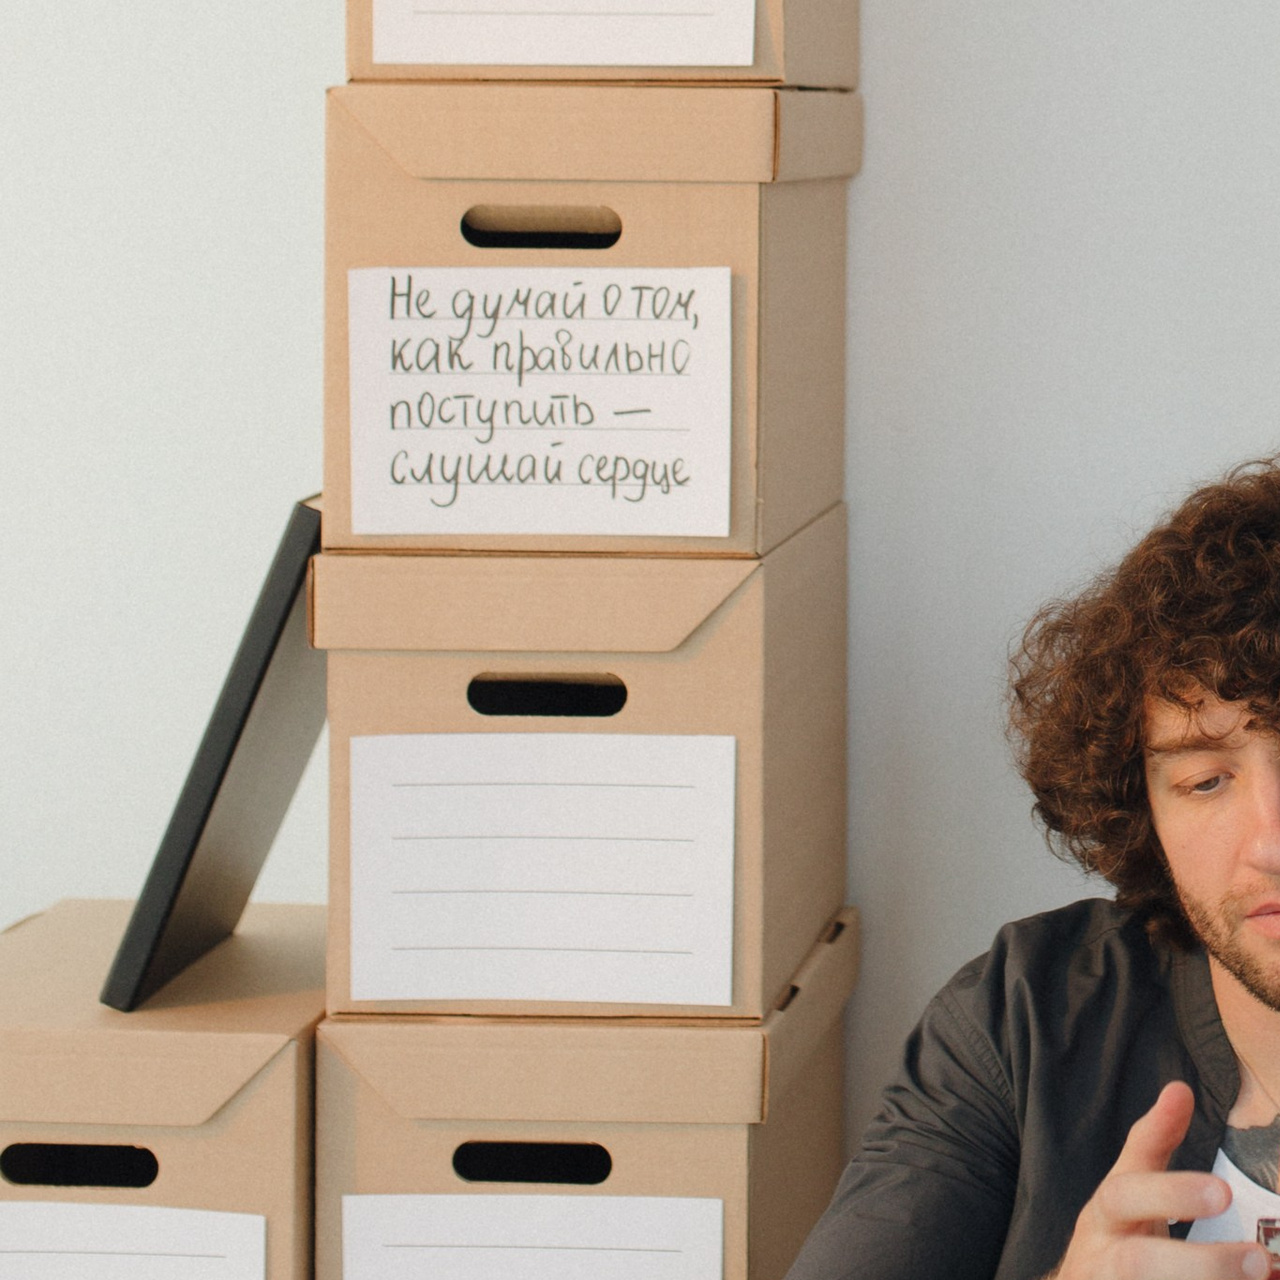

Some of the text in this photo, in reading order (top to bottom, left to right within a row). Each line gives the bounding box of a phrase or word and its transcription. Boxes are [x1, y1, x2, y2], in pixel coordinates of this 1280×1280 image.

[389, 274, 437, 320] Не
[450, 281, 586, 339] думай
[631, 285, 700, 330] том,
[390, 327, 692, 387] как правильно
[390, 391, 596, 444] поступить
[389, 441, 691, 508] слушай сердце
